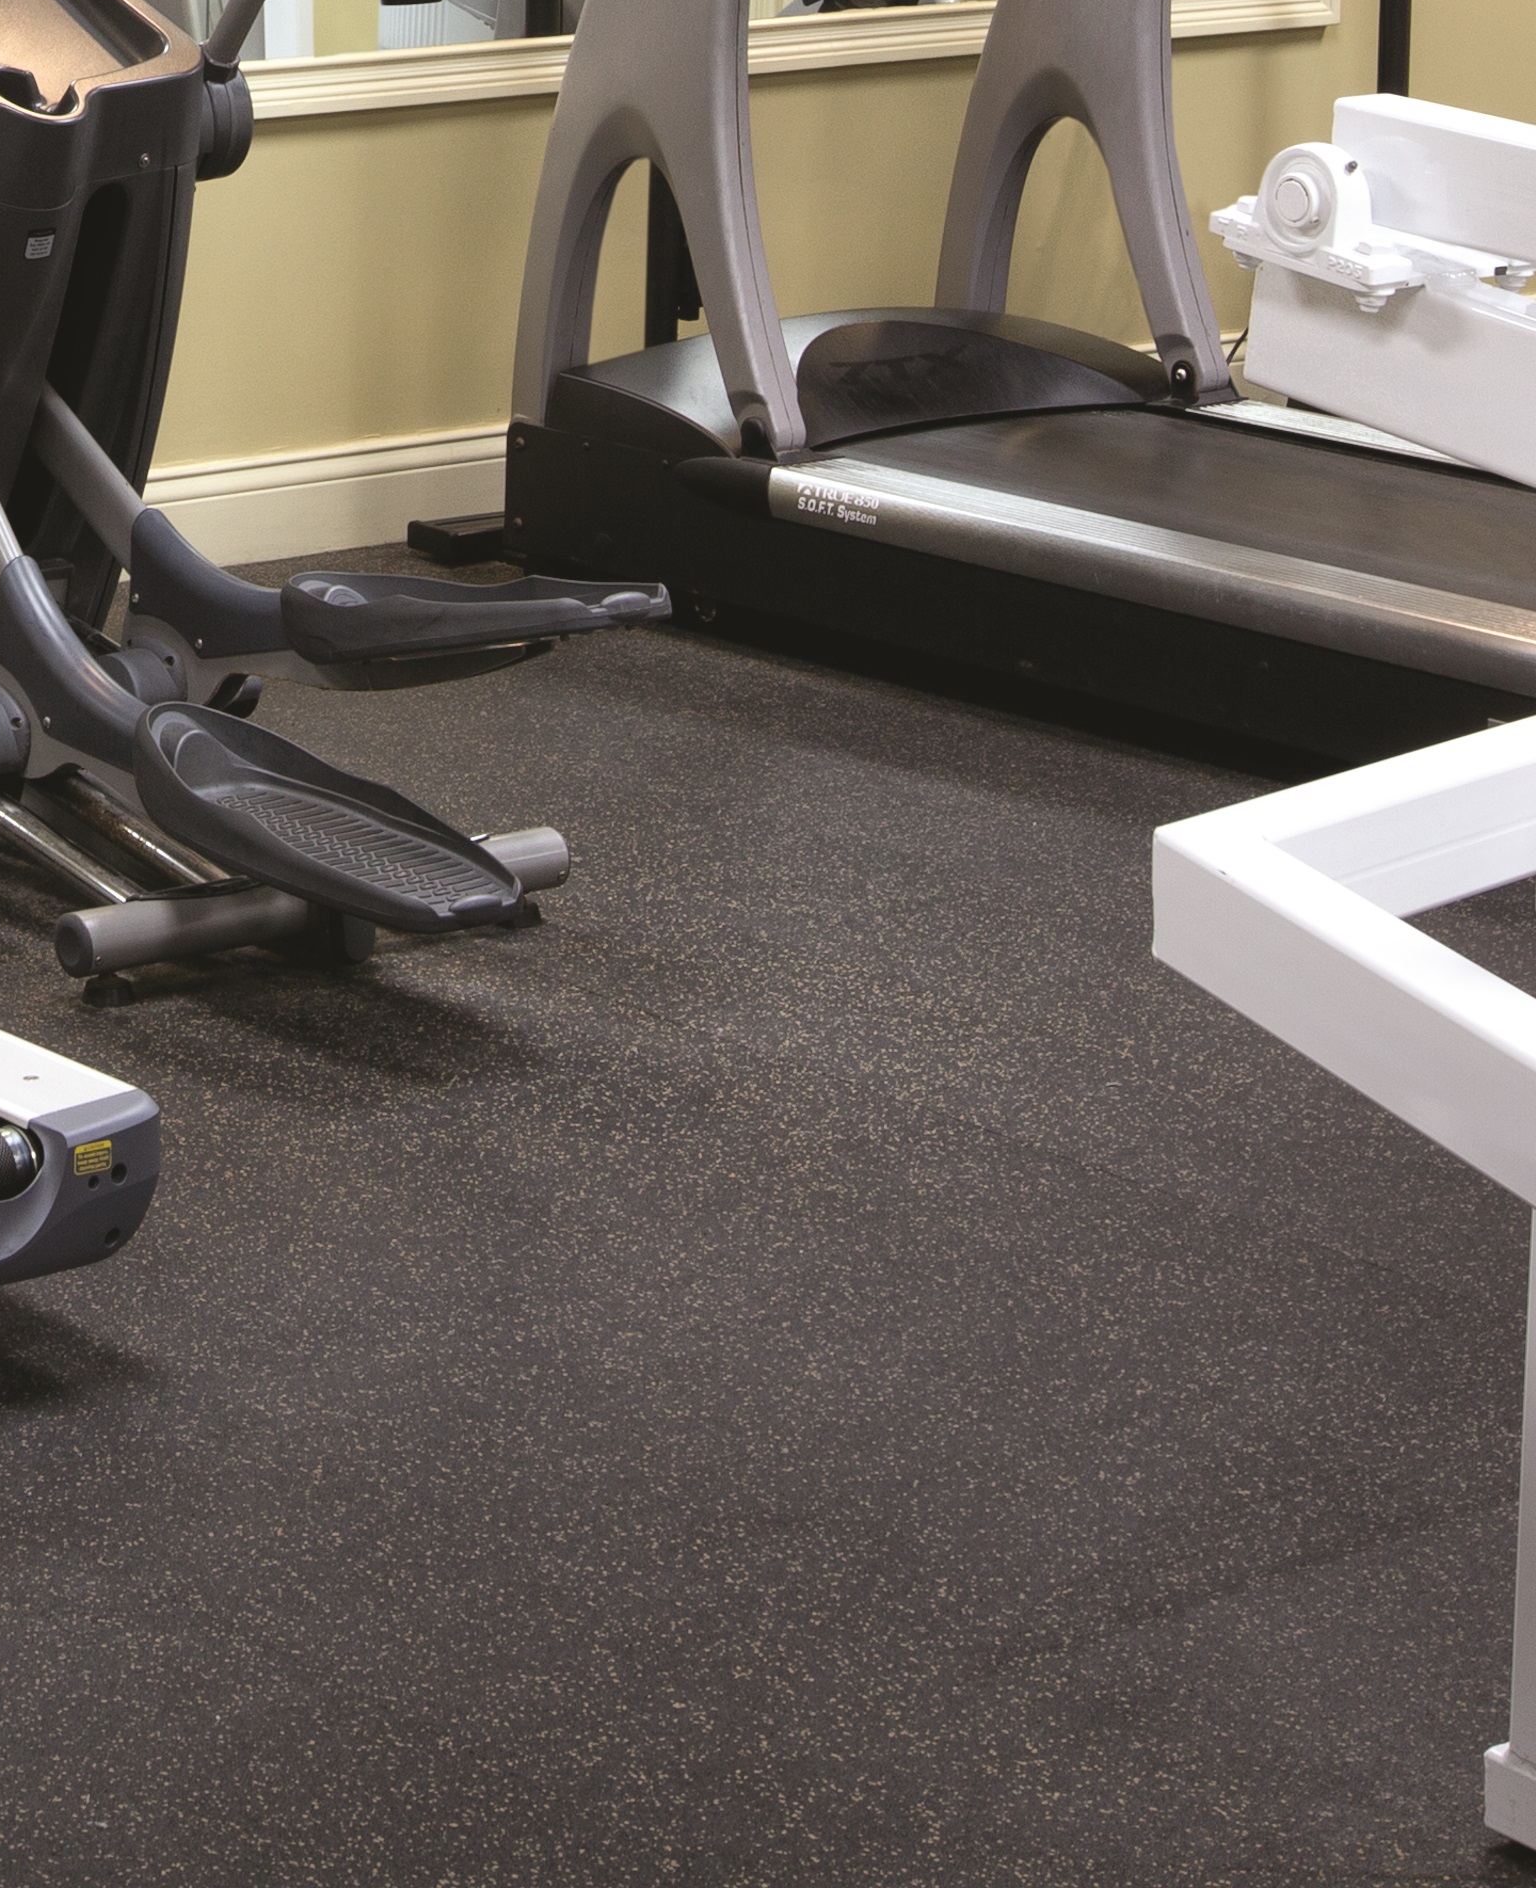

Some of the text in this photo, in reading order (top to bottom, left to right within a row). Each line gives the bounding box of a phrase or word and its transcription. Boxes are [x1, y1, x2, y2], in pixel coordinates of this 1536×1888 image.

[813, 485, 879, 509] TRUE 850
[837, 505, 876, 525] System
